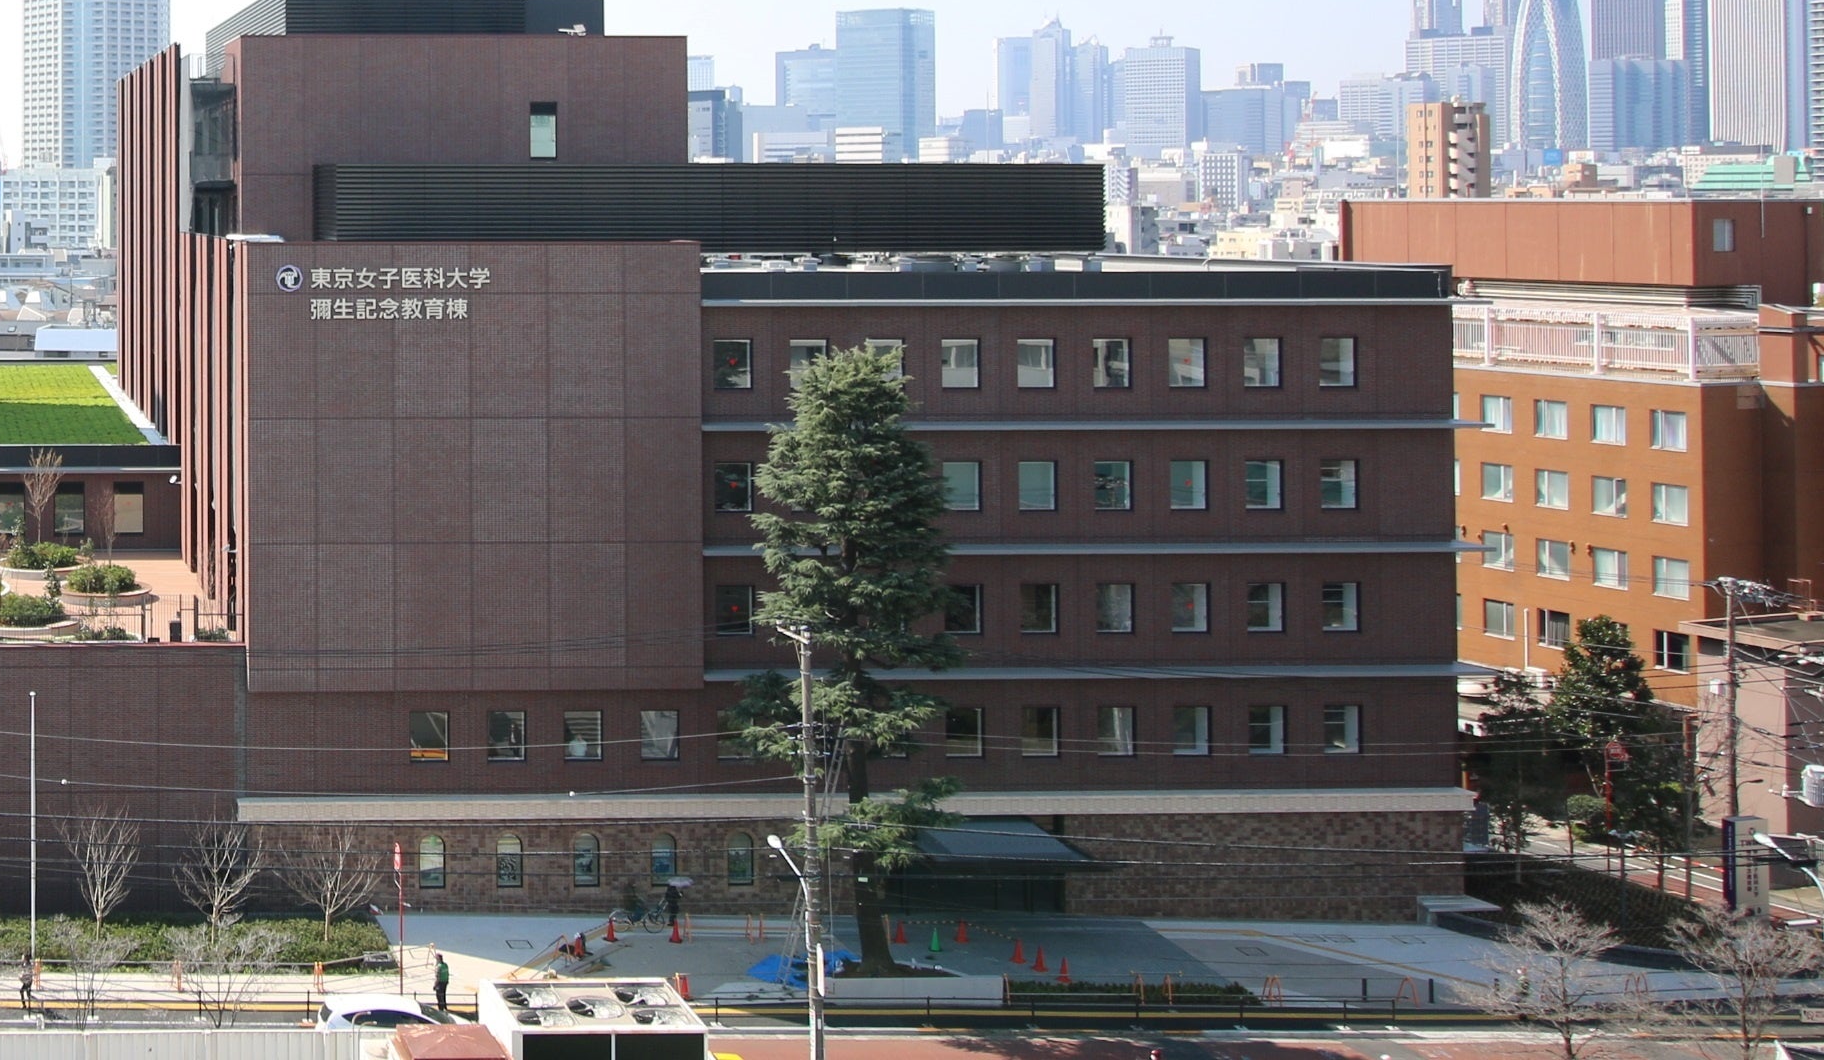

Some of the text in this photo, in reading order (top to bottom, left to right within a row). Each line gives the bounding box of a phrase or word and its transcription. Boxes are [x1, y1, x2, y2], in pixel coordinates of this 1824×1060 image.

[310, 267, 491, 290] 東京女子医科大学
[310, 298, 468, 320] 彌生記念教育棟
